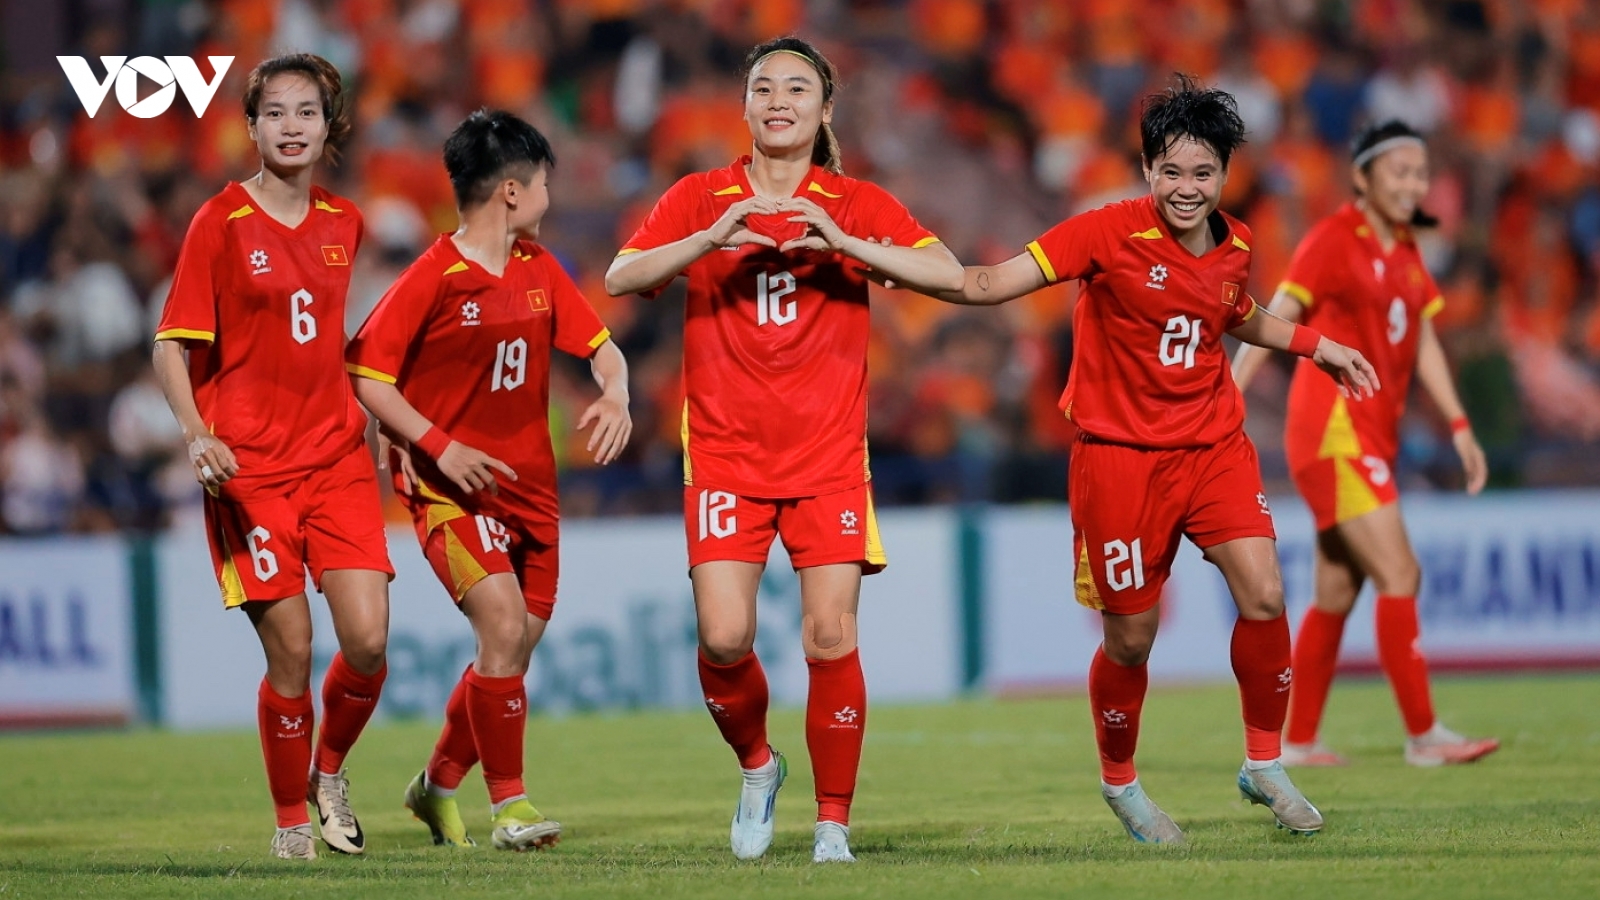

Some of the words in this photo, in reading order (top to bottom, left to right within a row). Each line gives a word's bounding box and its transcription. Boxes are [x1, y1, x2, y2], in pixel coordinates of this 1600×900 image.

[290, 287, 317, 345] 6
[757, 271, 798, 327] 12
[1387, 296, 1408, 345] 9
[491, 337, 528, 392] 19
[1158, 314, 1202, 370] 21
[698, 488, 737, 542] 12
[246, 525, 279, 583] 6
[1103, 537, 1145, 592] 21
